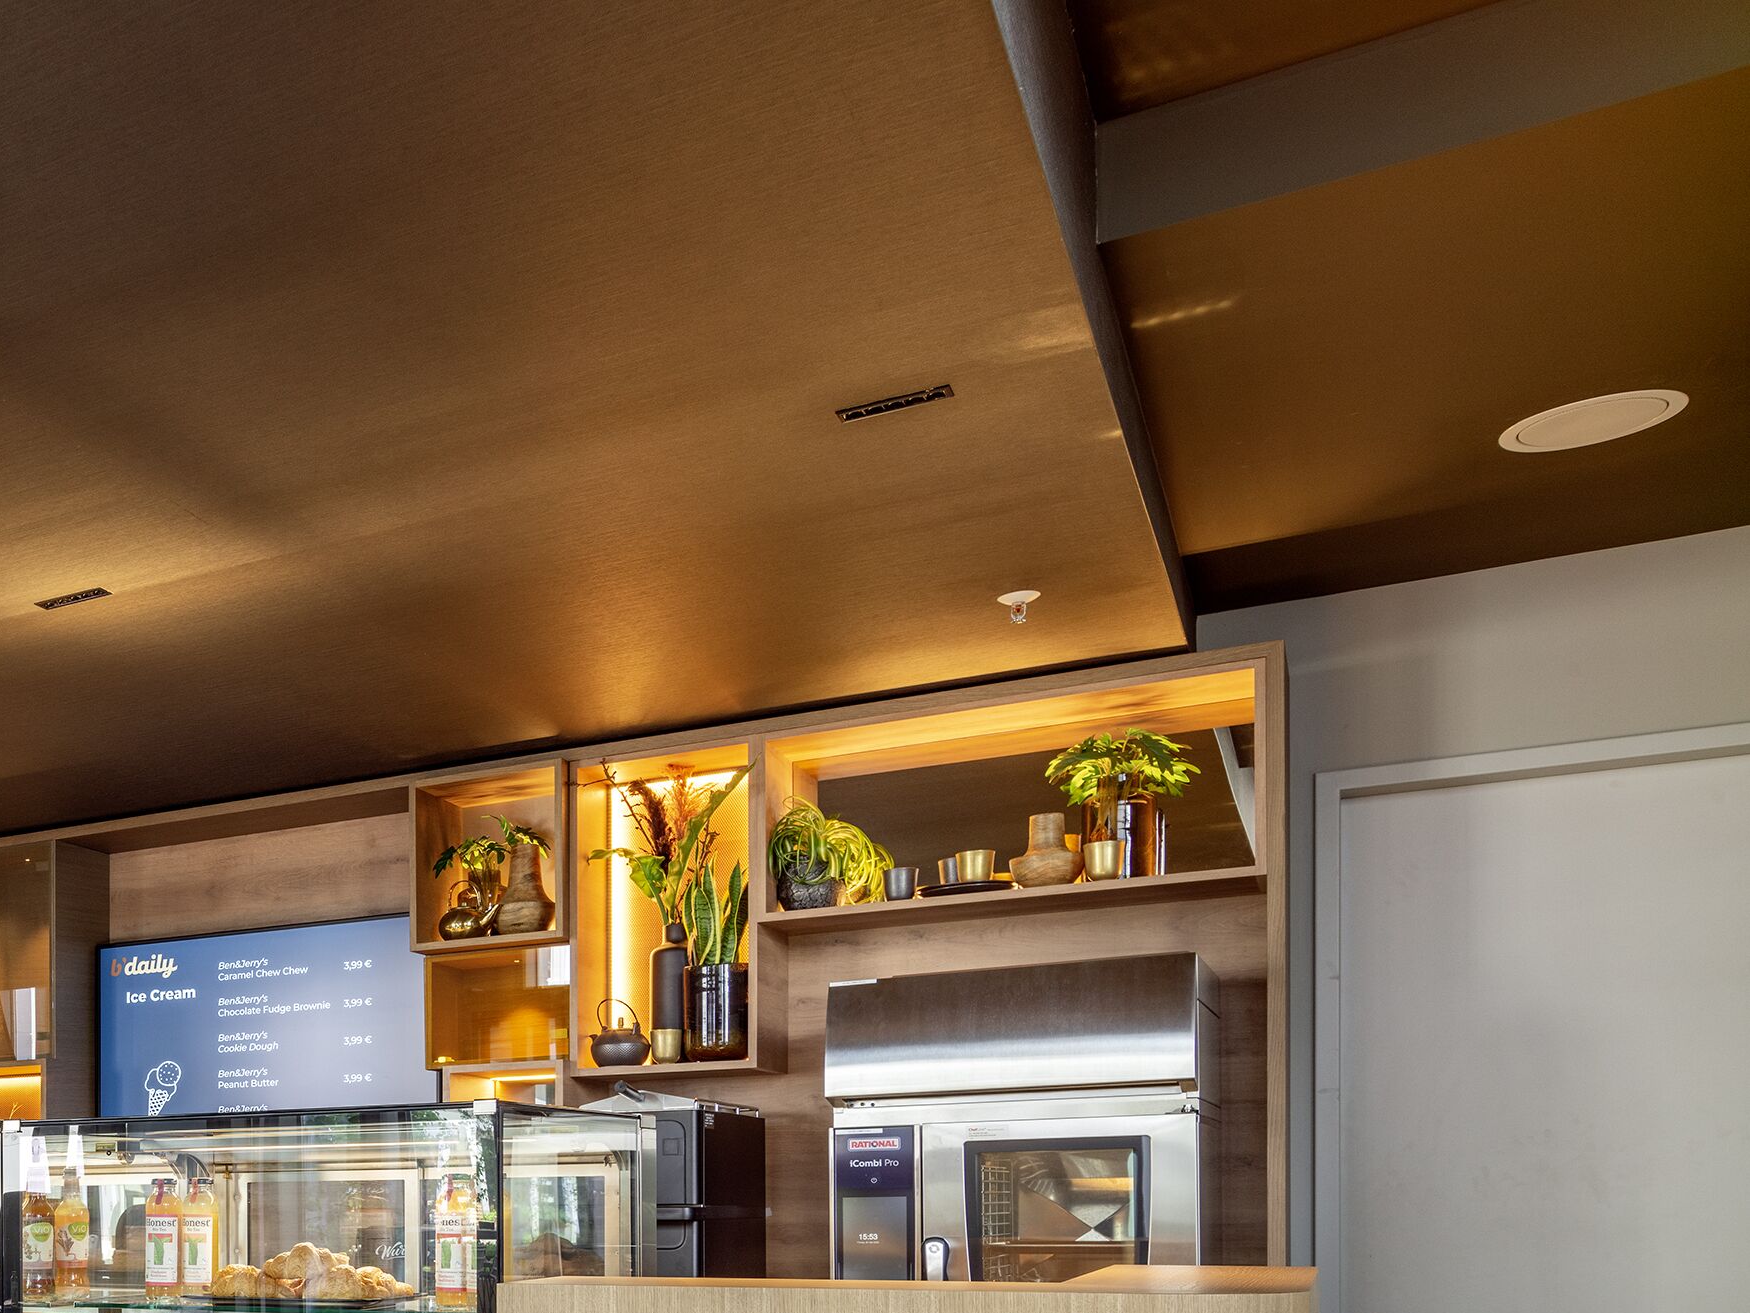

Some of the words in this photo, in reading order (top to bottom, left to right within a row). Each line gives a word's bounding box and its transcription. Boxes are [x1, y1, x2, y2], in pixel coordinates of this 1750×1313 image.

[110, 954, 178, 979] b'daily
[218, 957, 269, 970] Ben&Jerry's
[343, 961, 363, 972] 3,99
[364, 959, 372, 968] €
[218, 970, 254, 981] Caramel
[256, 968, 281, 978] Chew
[282, 966, 308, 975] Chew
[126, 991, 147, 1004] Ice
[150, 988, 196, 1002] Cream
[218, 994, 269, 1006] Ben&Jerry's
[343, 998, 363, 1009] 3,99
[364, 997, 372, 1006] €
[218, 1007, 261, 1018] Chocolate
[263, 1003, 291, 1014] Fudge
[294, 1001, 331, 1012] Brownie
[218, 1030, 268, 1042] Ben&Jerry's
[343, 1035, 363, 1047] 3,99
[364, 1035, 372, 1044] €
[218, 1043, 247, 1053] Cookie
[249, 1041, 279, 1052] Dough
[218, 1067, 268, 1078] Ben&Jerry's
[343, 1073, 363, 1084] 3,99
[364, 1073, 372, 1082] €
[218, 1080, 249, 1089] Peanut
[250, 1078, 279, 1088] Butter
[851, 1140, 897, 1149] RATIONAL
[850, 1159, 882, 1168] iCombi
[884, 1159, 899, 1167] Pro
